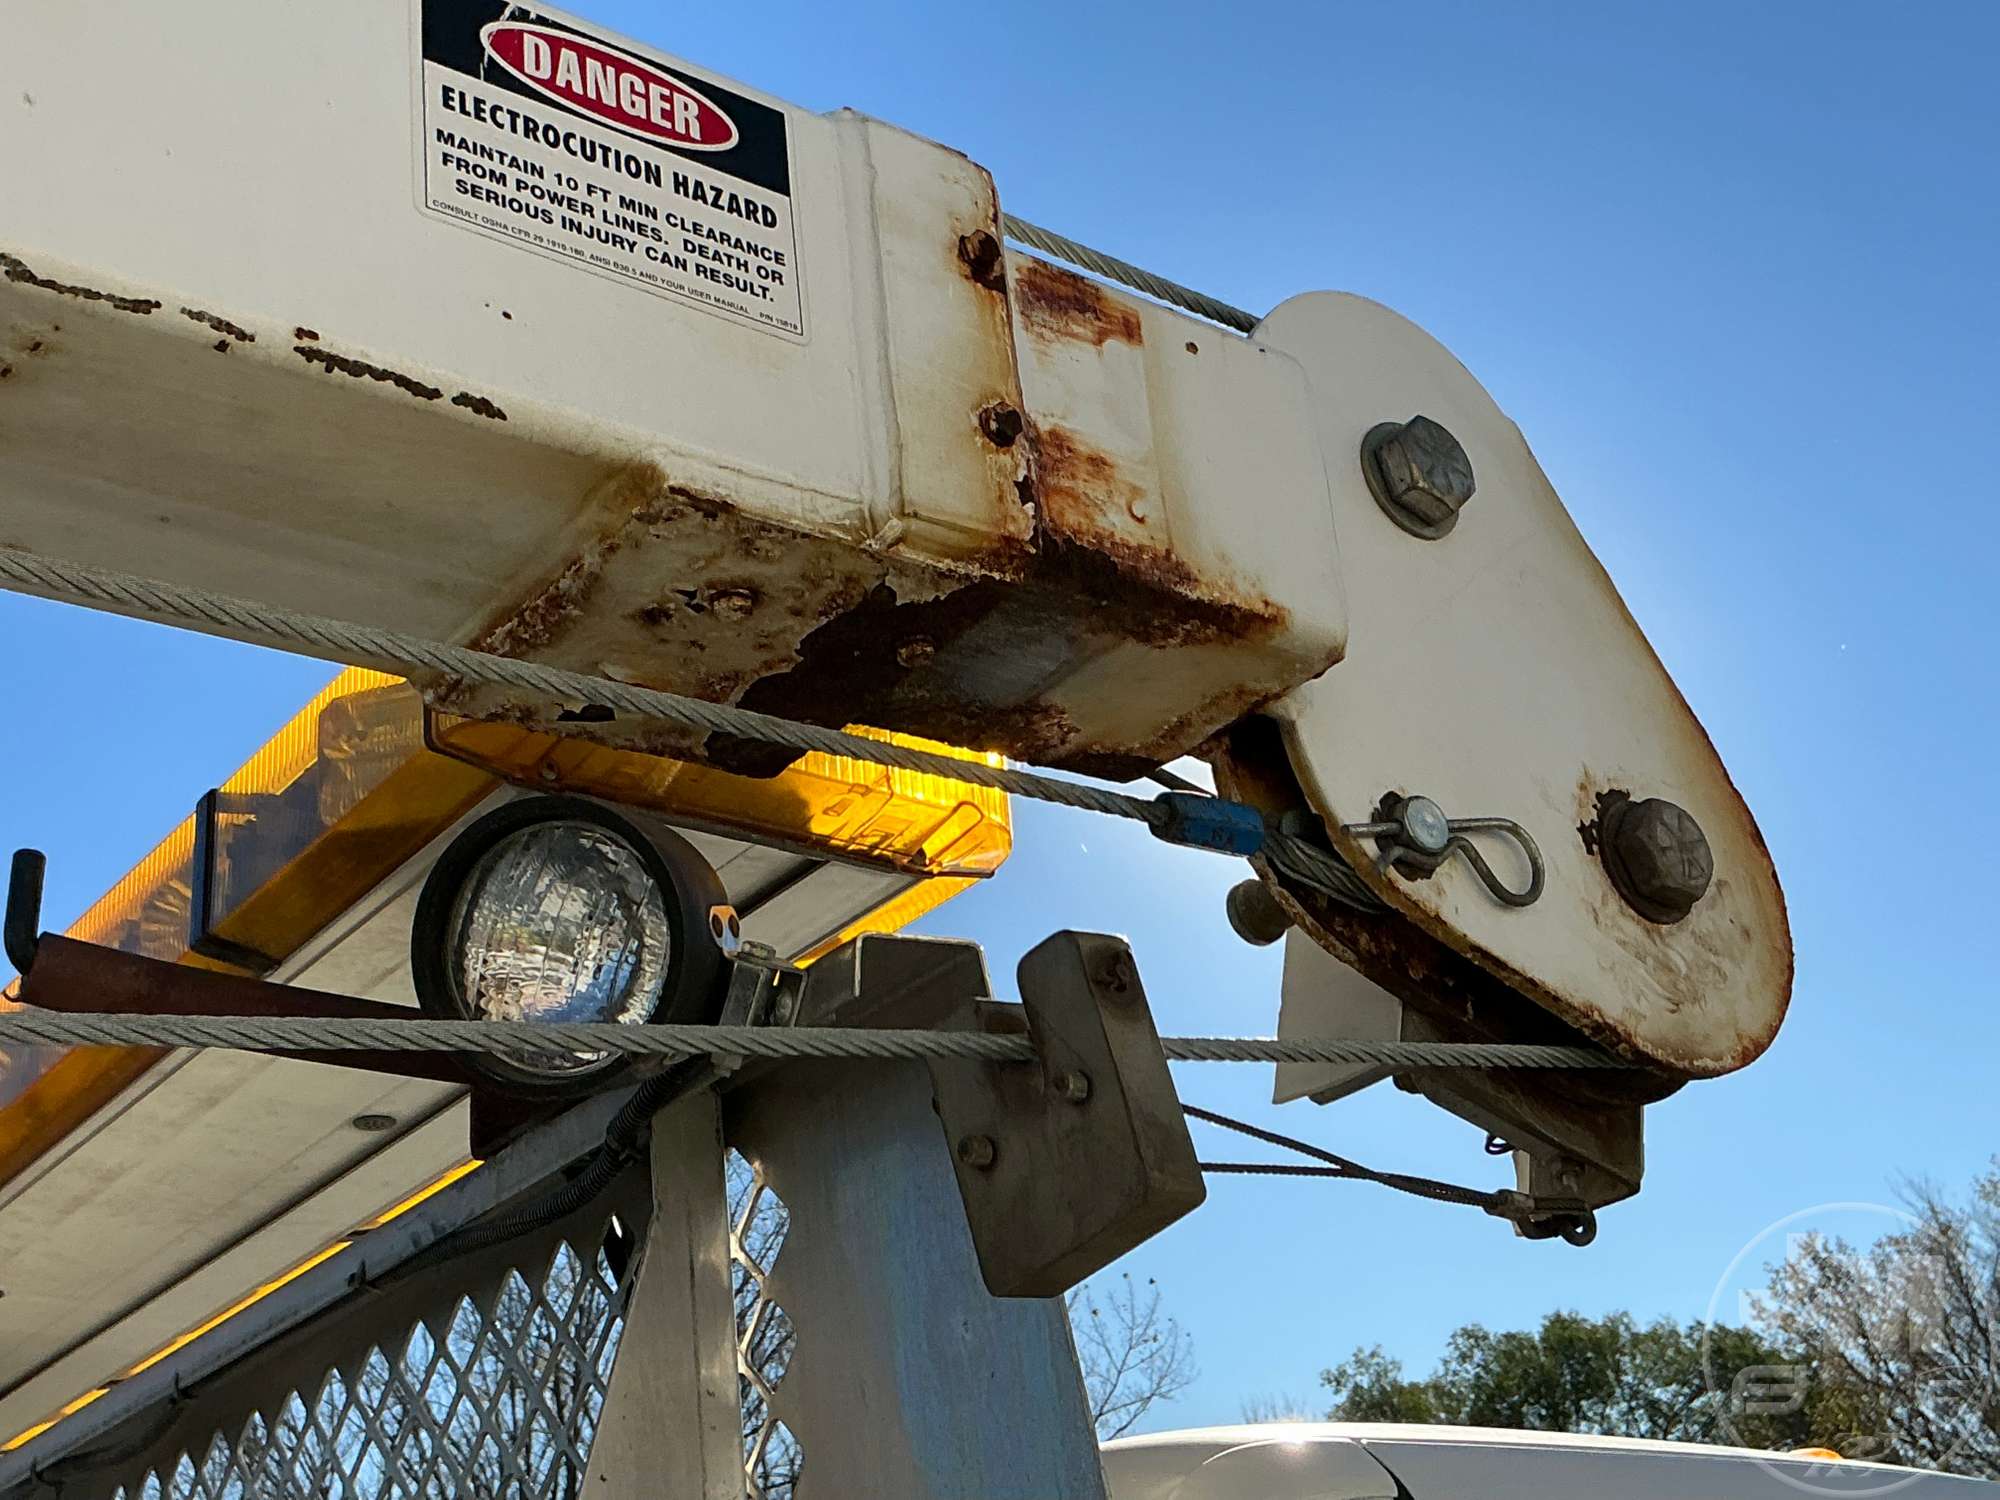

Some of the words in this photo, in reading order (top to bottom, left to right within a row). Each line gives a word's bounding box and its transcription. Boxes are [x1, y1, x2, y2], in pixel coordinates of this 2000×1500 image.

[522, 31, 703, 141] DANGER
[436, 127, 545, 180] MAINTAIN
[553, 172, 579, 191] 10
[586, 182, 612, 203] FT
[618, 194, 658, 221] MIN
[665, 212, 787, 267] CLEARANCE
[441, 84, 662, 188] ELECTROCUTION
[672, 171, 778, 229] HAZARD
[441, 151, 508, 188] FROM
[515, 178, 596, 219] POWER
[602, 209, 669, 245] LINES.
[683, 237, 750, 274] DEATH
[756, 265, 785, 286] OR
[432, 199, 479, 220] CONSULT
[481, 215, 509, 231] OSHA
[589, 253, 611, 267] ANSI
[639, 271, 658, 282] AND
[660, 277, 685, 292] YOUR
[687, 287, 712, 301] USER
[713, 296, 750, 315] MANUAL
[455, 178, 554, 225] SERIOUS
[560, 215, 638, 254] INJURY
[645, 246, 688, 272] CAN
[694, 262, 775, 302] RESULT.
